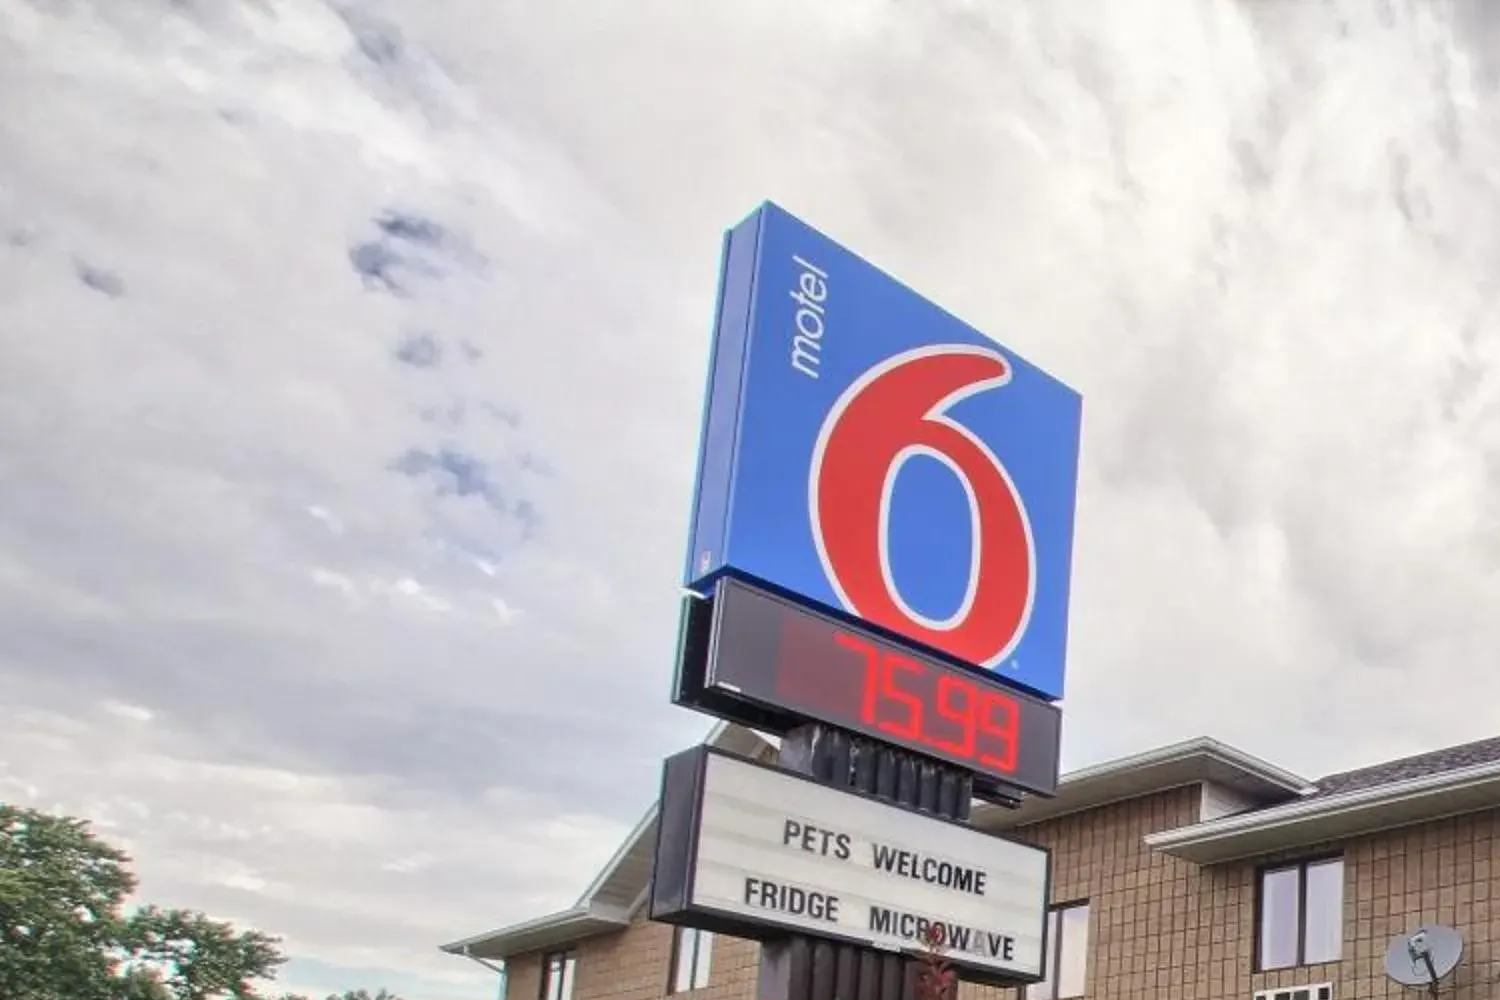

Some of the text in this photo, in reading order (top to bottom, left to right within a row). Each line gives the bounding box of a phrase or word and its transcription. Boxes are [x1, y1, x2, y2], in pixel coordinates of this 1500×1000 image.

[789, 255, 829, 379] motel
[808, 343, 1037, 669] 6
[744, 877, 840, 923] FRIDGE
[783, 819, 988, 896] PETS WELCOME
